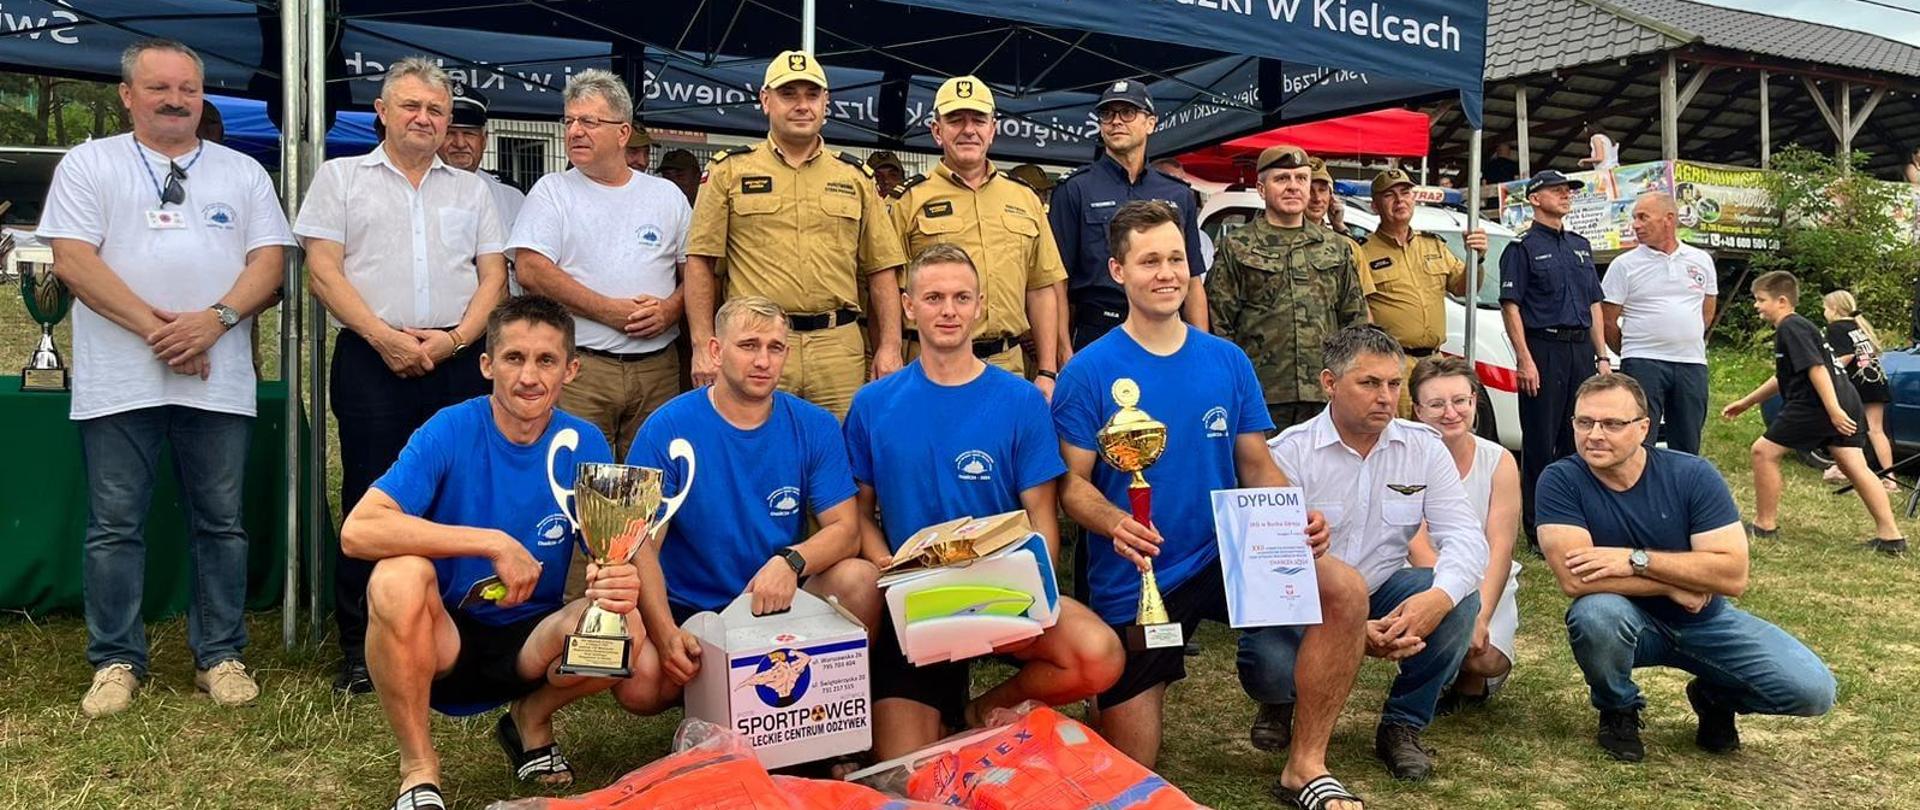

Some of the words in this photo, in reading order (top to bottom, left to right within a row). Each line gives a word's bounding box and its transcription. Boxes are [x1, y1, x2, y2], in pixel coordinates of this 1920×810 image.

[1267, 0, 1301, 23] w
[1313, 0, 1461, 52] Kielcach
[1237, 493, 1299, 508] DYPLOM
[749, 731, 783, 747] LECKIE
[784, 725, 825, 741] CENTRUM
